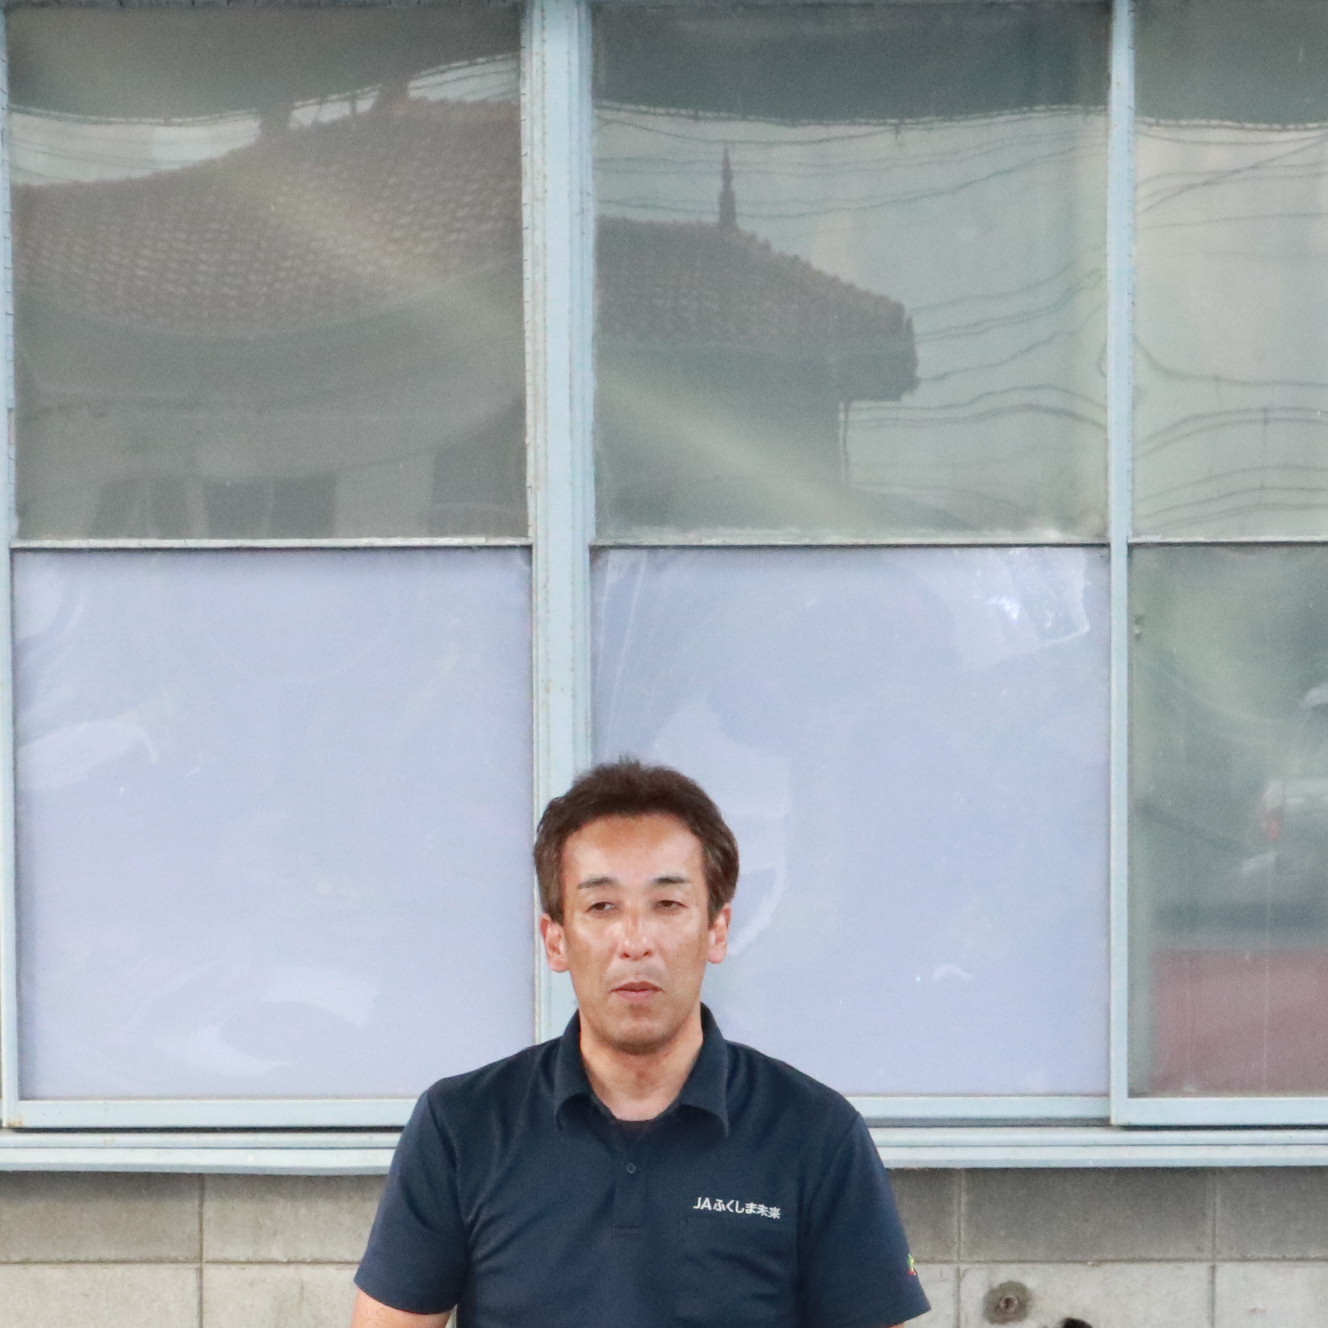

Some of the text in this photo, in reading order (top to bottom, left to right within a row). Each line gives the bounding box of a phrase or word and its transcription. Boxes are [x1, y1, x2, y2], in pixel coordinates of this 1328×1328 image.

[693, 1197, 781, 1219] JAふくしま未来
